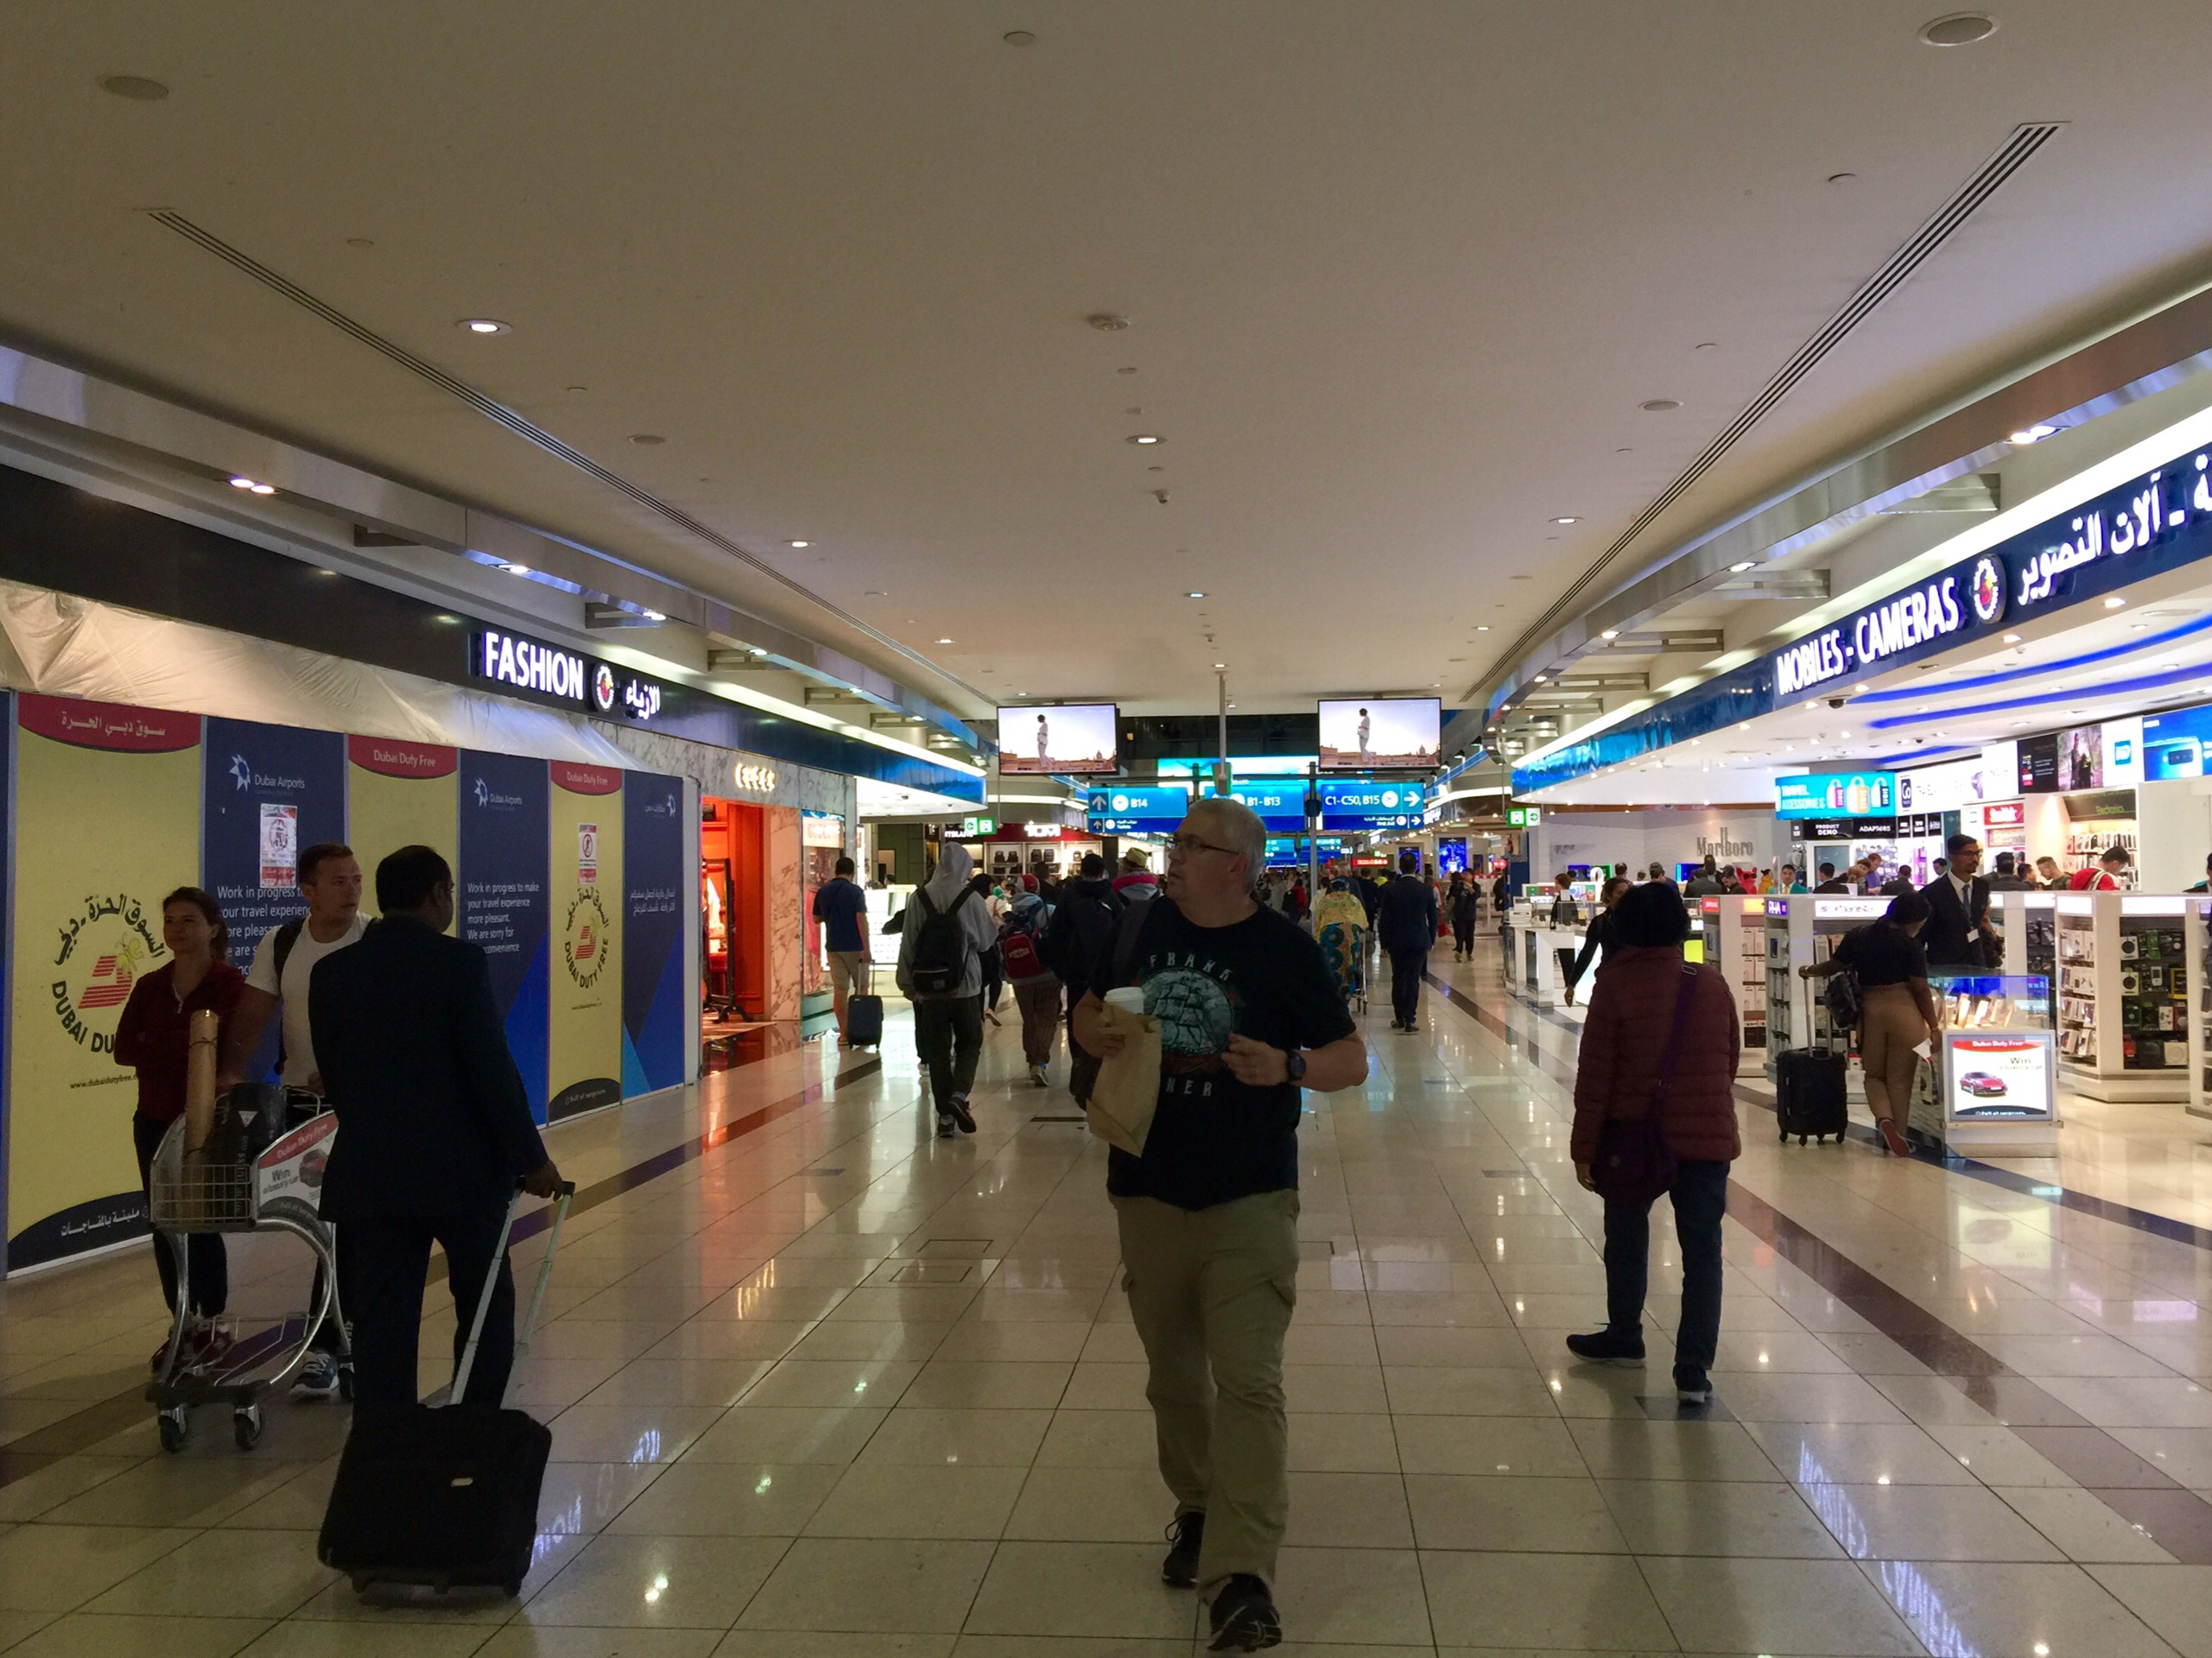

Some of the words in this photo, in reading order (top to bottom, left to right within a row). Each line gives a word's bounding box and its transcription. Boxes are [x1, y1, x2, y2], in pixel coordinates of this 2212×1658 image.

[2017, 510, 2103, 606] التصوير
[1777, 630, 1844, 696] MOBILES
[1856, 577, 1959, 664] CAMERAS
[485, 631, 584, 700] FASHION
[61, 711, 103, 731] الحرة
[136, 719, 166, 738] سوق
[105, 722, 134, 737] دبي
[374, 750, 398, 763] Dubai
[399, 750, 418, 768] Duty
[419, 752, 436, 767] Free
[255, 774, 276, 786] Dubai
[277, 776, 305, 790] Airports
[567, 771, 582, 782] Dubai
[583, 773, 596, 786] Duty
[597, 774, 608, 786] Free
[490, 793, 504, 804] Dubai
[1130, 798, 1148, 808] B14
[1362, 795, 1380, 806] B15
[1696, 827, 1754, 857] Marlboro
[217, 885, 244, 899] Work
[245, 886, 255, 898] in
[257, 887, 295, 901] progress
[467, 883, 484, 893] Work
[485, 884, 491, 893] in
[492, 883, 517, 895] progress
[517, 883, 524, 892] to
[524, 882, 540, 892] make
[85, 893, 128, 922] الحرة
[220, 907, 239, 919] our
[242, 904, 268, 917] travel
[269, 903, 309, 919] experien
[467, 900, 482, 912] your
[483, 897, 500, 908] travel
[500, 898, 530, 908] experience
[467, 915, 484, 924] more
[227, 927, 242, 938] ore
[467, 929, 479, 940] We
[479, 930, 489, 940] are
[490, 929, 504, 940] sorry
[505, 926, 515, 938] for
[235, 946, 250, 957] are
[564, 941, 579, 983] DUBAI
[580, 971, 599, 989] DUTY
[597, 938, 609, 973] FREE
[1149, 951, 1233, 981] FRANK
[52, 980, 89, 1046] DUBAI
[91, 1032, 115, 1054] DU
[271, 1168, 291, 1182] Win
